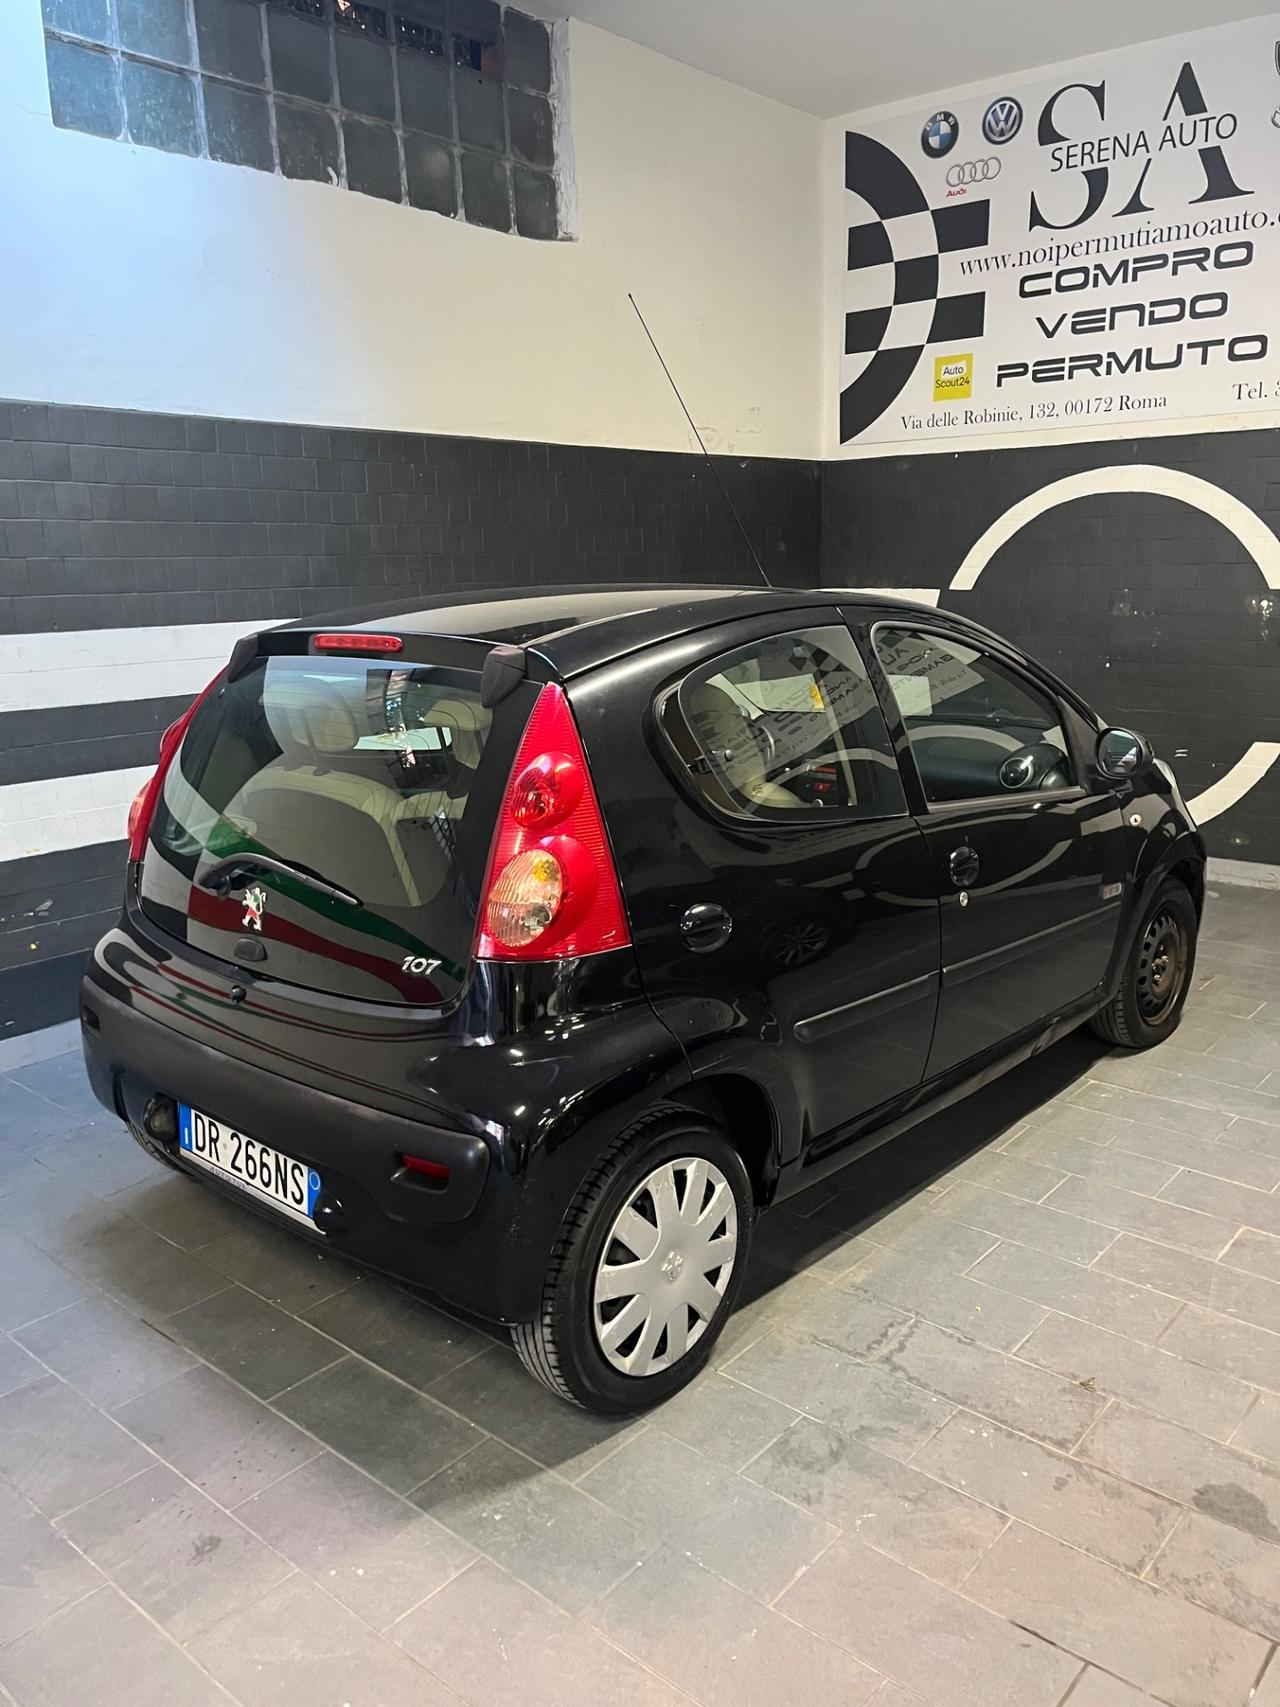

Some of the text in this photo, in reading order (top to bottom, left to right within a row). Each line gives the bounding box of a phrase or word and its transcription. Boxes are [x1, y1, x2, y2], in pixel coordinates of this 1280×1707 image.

[1050, 113, 1238, 172] SERENA AUTO
[946, 187, 967, 198] Audi
[1018, 240, 1254, 299] COMPRO
[1036, 291, 1229, 339] VENDO
[942, 365, 965, 376] Auto
[996, 334, 1268, 388] PERMUTO
[935, 376, 971, 389] Scout24
[1232, 380, 1268, 401] Tel.
[901, 394, 1168, 430] Via delle Robinie, 132, 00172 Roma
[401, 956, 442, 975] 107
[194, 1112, 220, 1163] DR
[230, 1132, 305, 1206] 266NS
